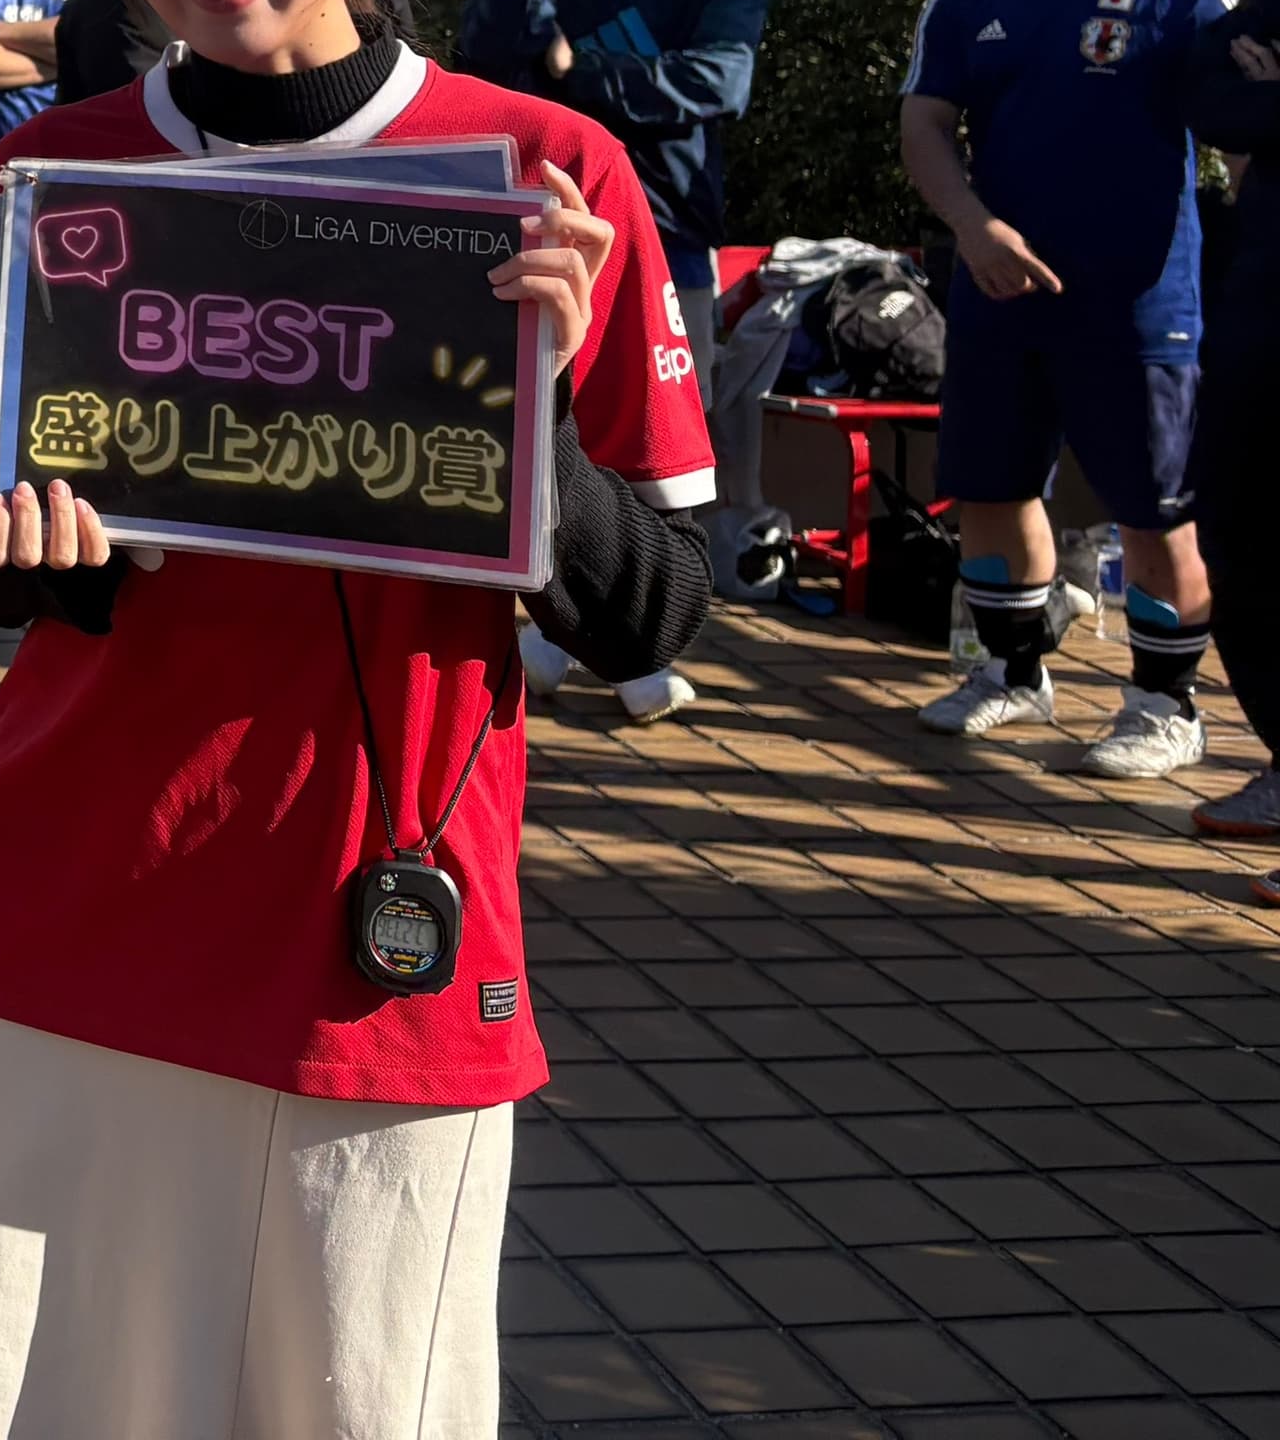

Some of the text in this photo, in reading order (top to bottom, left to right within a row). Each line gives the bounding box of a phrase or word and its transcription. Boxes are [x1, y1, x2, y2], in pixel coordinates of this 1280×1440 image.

[118, 288, 394, 392] BEST
[30, 390, 507, 514] 盛り上がり賞
